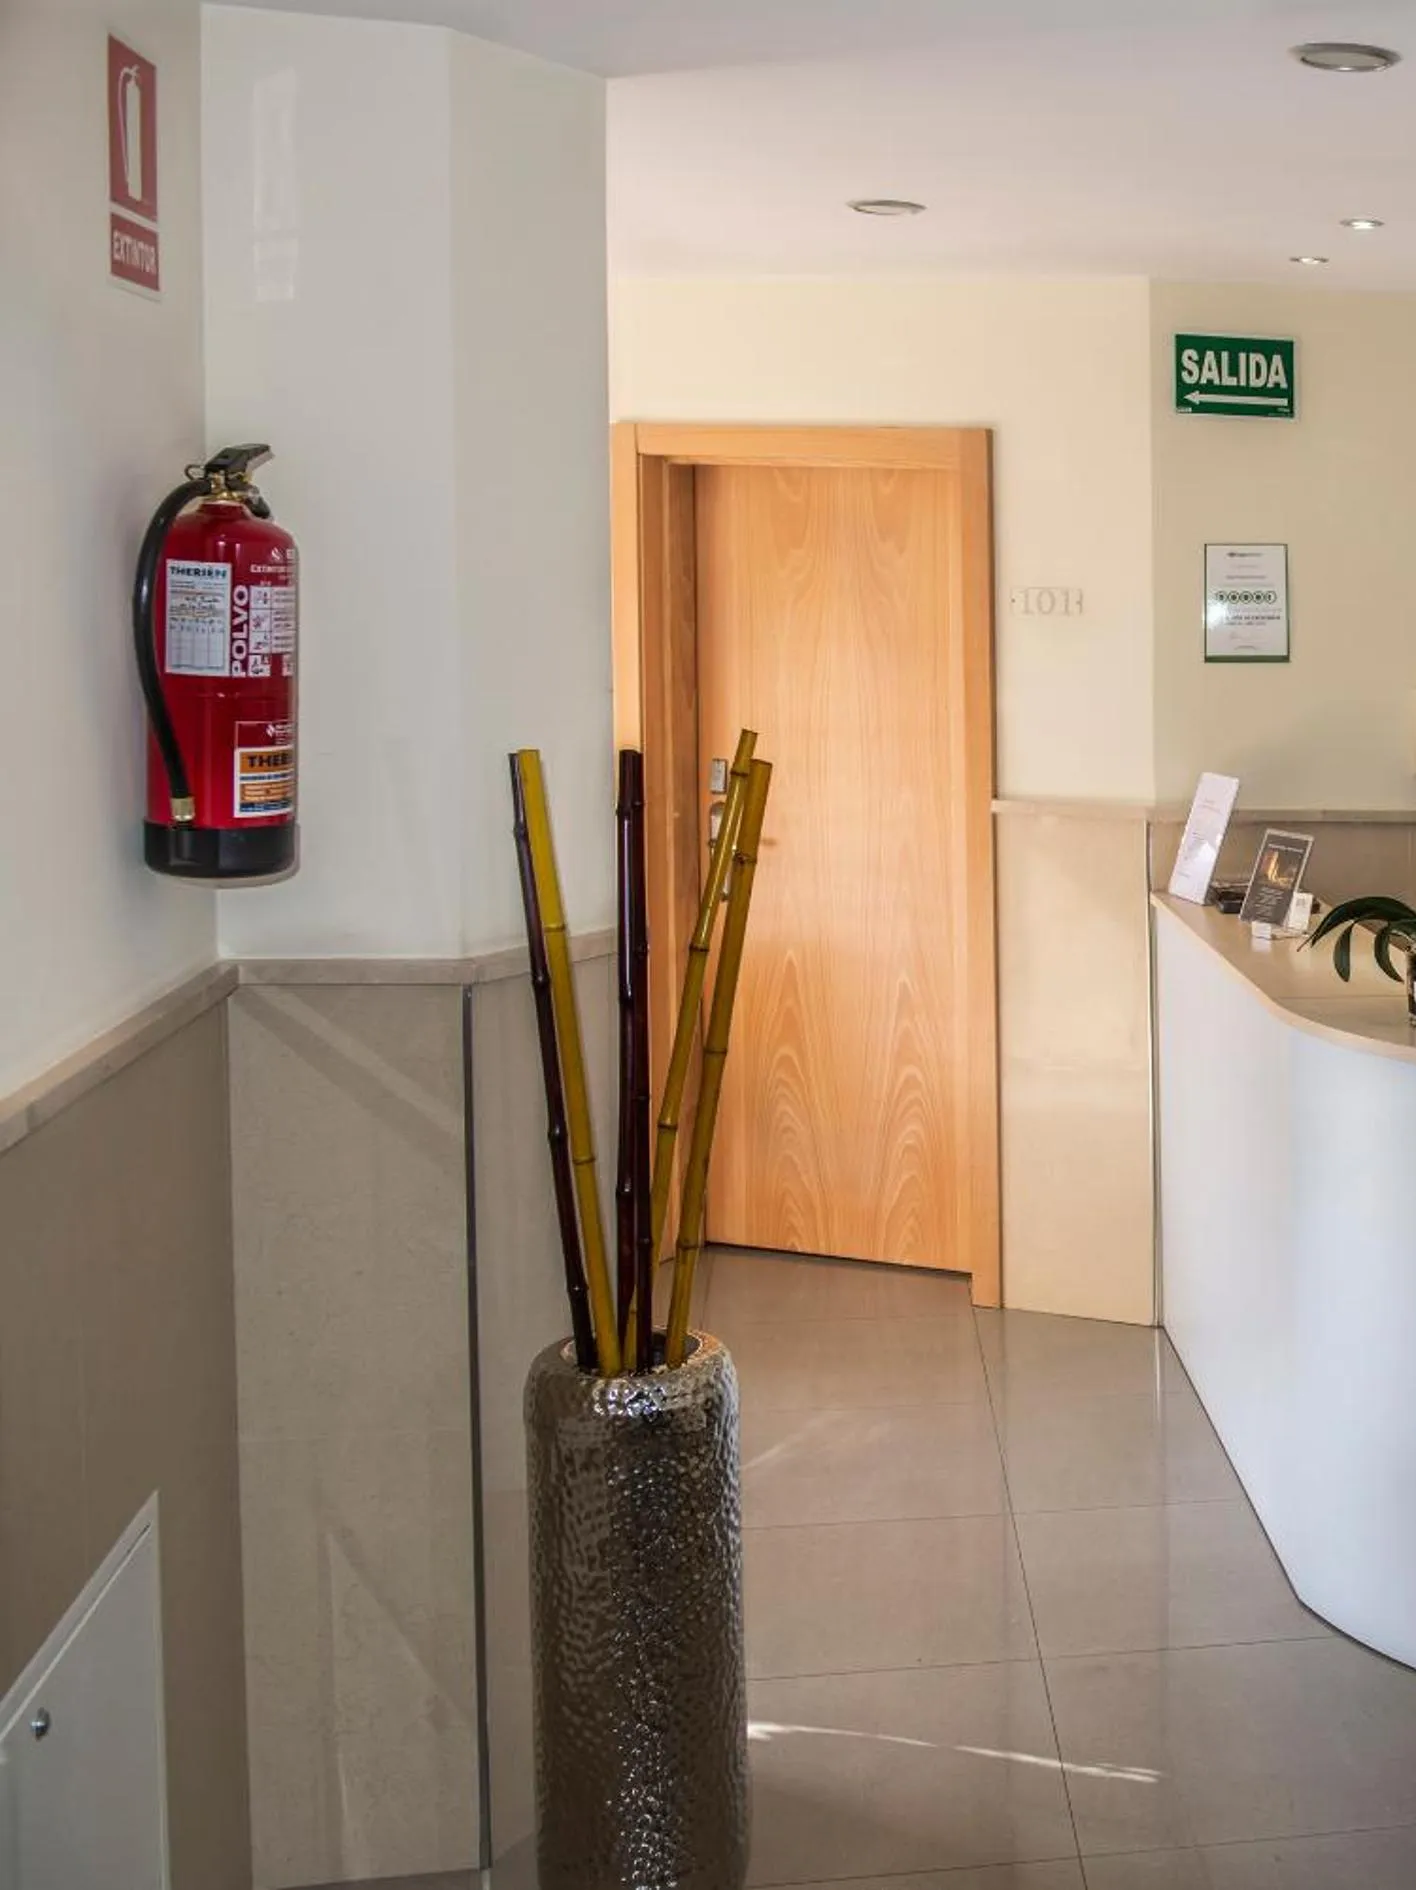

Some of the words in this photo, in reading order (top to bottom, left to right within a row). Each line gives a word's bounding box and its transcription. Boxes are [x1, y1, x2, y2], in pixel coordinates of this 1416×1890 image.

[113, 229, 156, 276] EXTINTOR
[1181, 348, 1288, 389] SALIDA
[231, 584, 249, 678] POLVO
